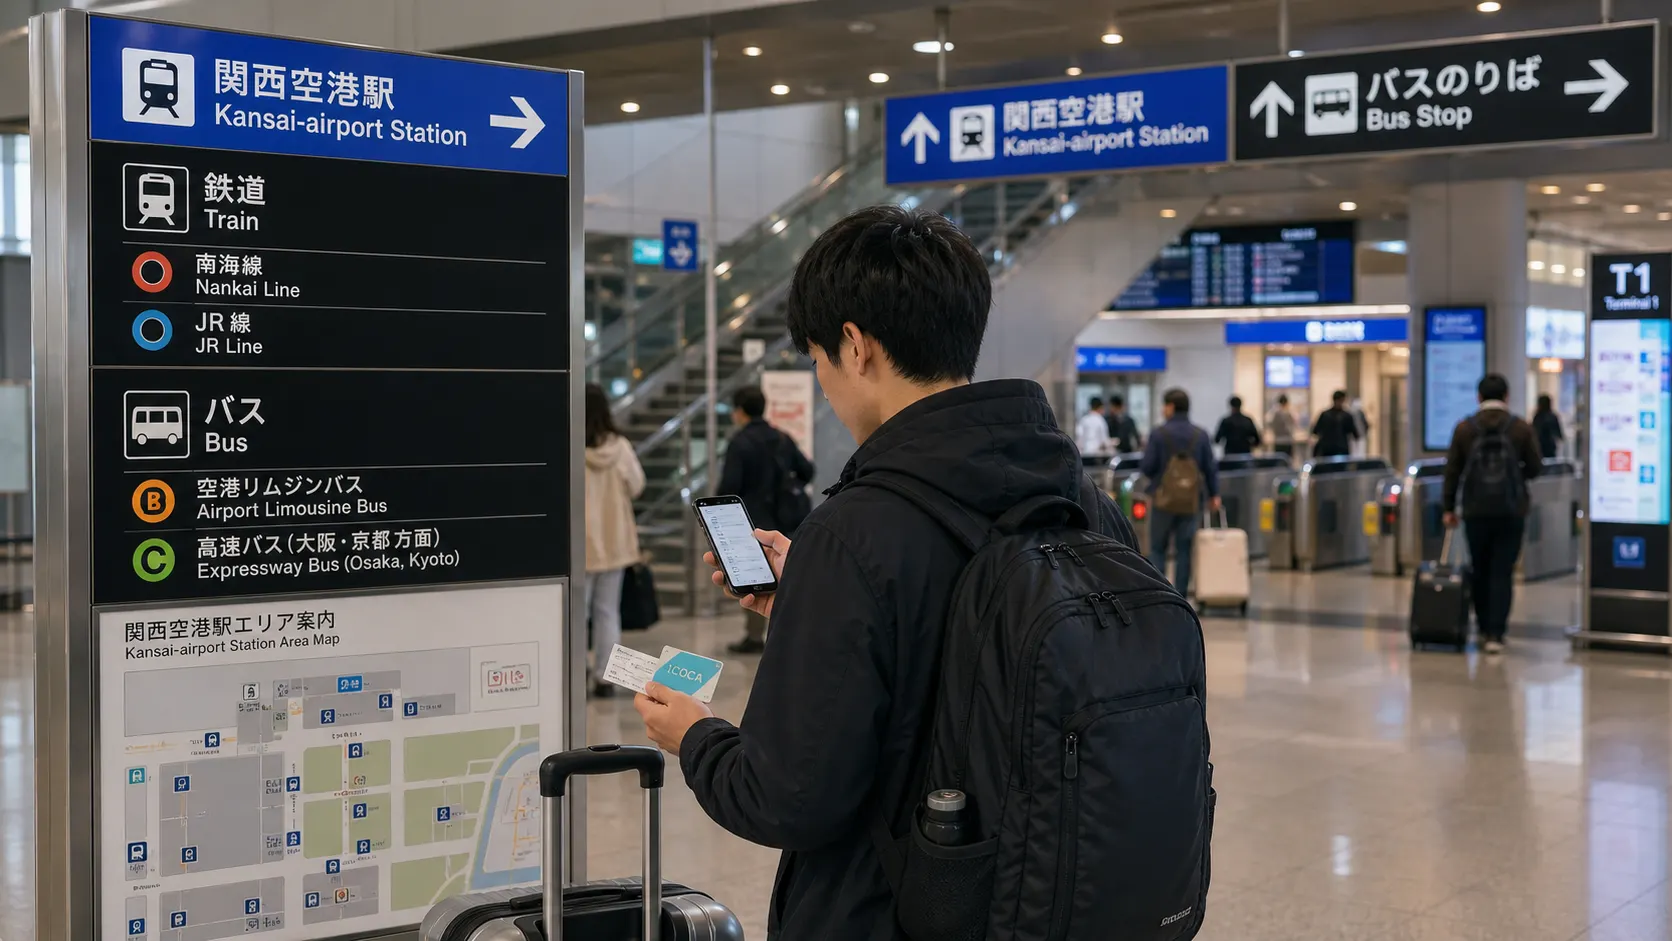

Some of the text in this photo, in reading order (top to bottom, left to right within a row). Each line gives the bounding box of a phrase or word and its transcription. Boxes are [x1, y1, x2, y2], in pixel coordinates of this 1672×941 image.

[214, 58, 395, 111] 関西空港駅
[1365, 54, 1543, 103] バスのりば
[215, 102, 467, 147] Kansai-airport Station
[1003, 90, 1145, 133] 関西空港駅
[1366, 103, 1473, 132] Bus Stop
[1003, 122, 1209, 157] Kansai-airport Station
[203, 171, 266, 206] 鉄道
[203, 208, 259, 231] Train
[195, 252, 263, 277] 南海線
[1608, 262, 1651, 295] T1
[195, 278, 301, 298] Nankai Line
[1604, 295, 1652, 311] Terminal
[195, 311, 251, 334] JR 線
[195, 337, 263, 355] JR Line
[204, 394, 266, 425] バス
[205, 432, 248, 453] Bus
[196, 474, 363, 499] 空港リムジンバス
[196, 498, 388, 523] Airport Limousine Bus
[197, 549, 460, 582] Expressway Bus (Osaka, Kyoto)
[125, 609, 335, 643] 関西空港駅エリア案内
[125, 633, 340, 660] Kansai-airport Station Area Map
